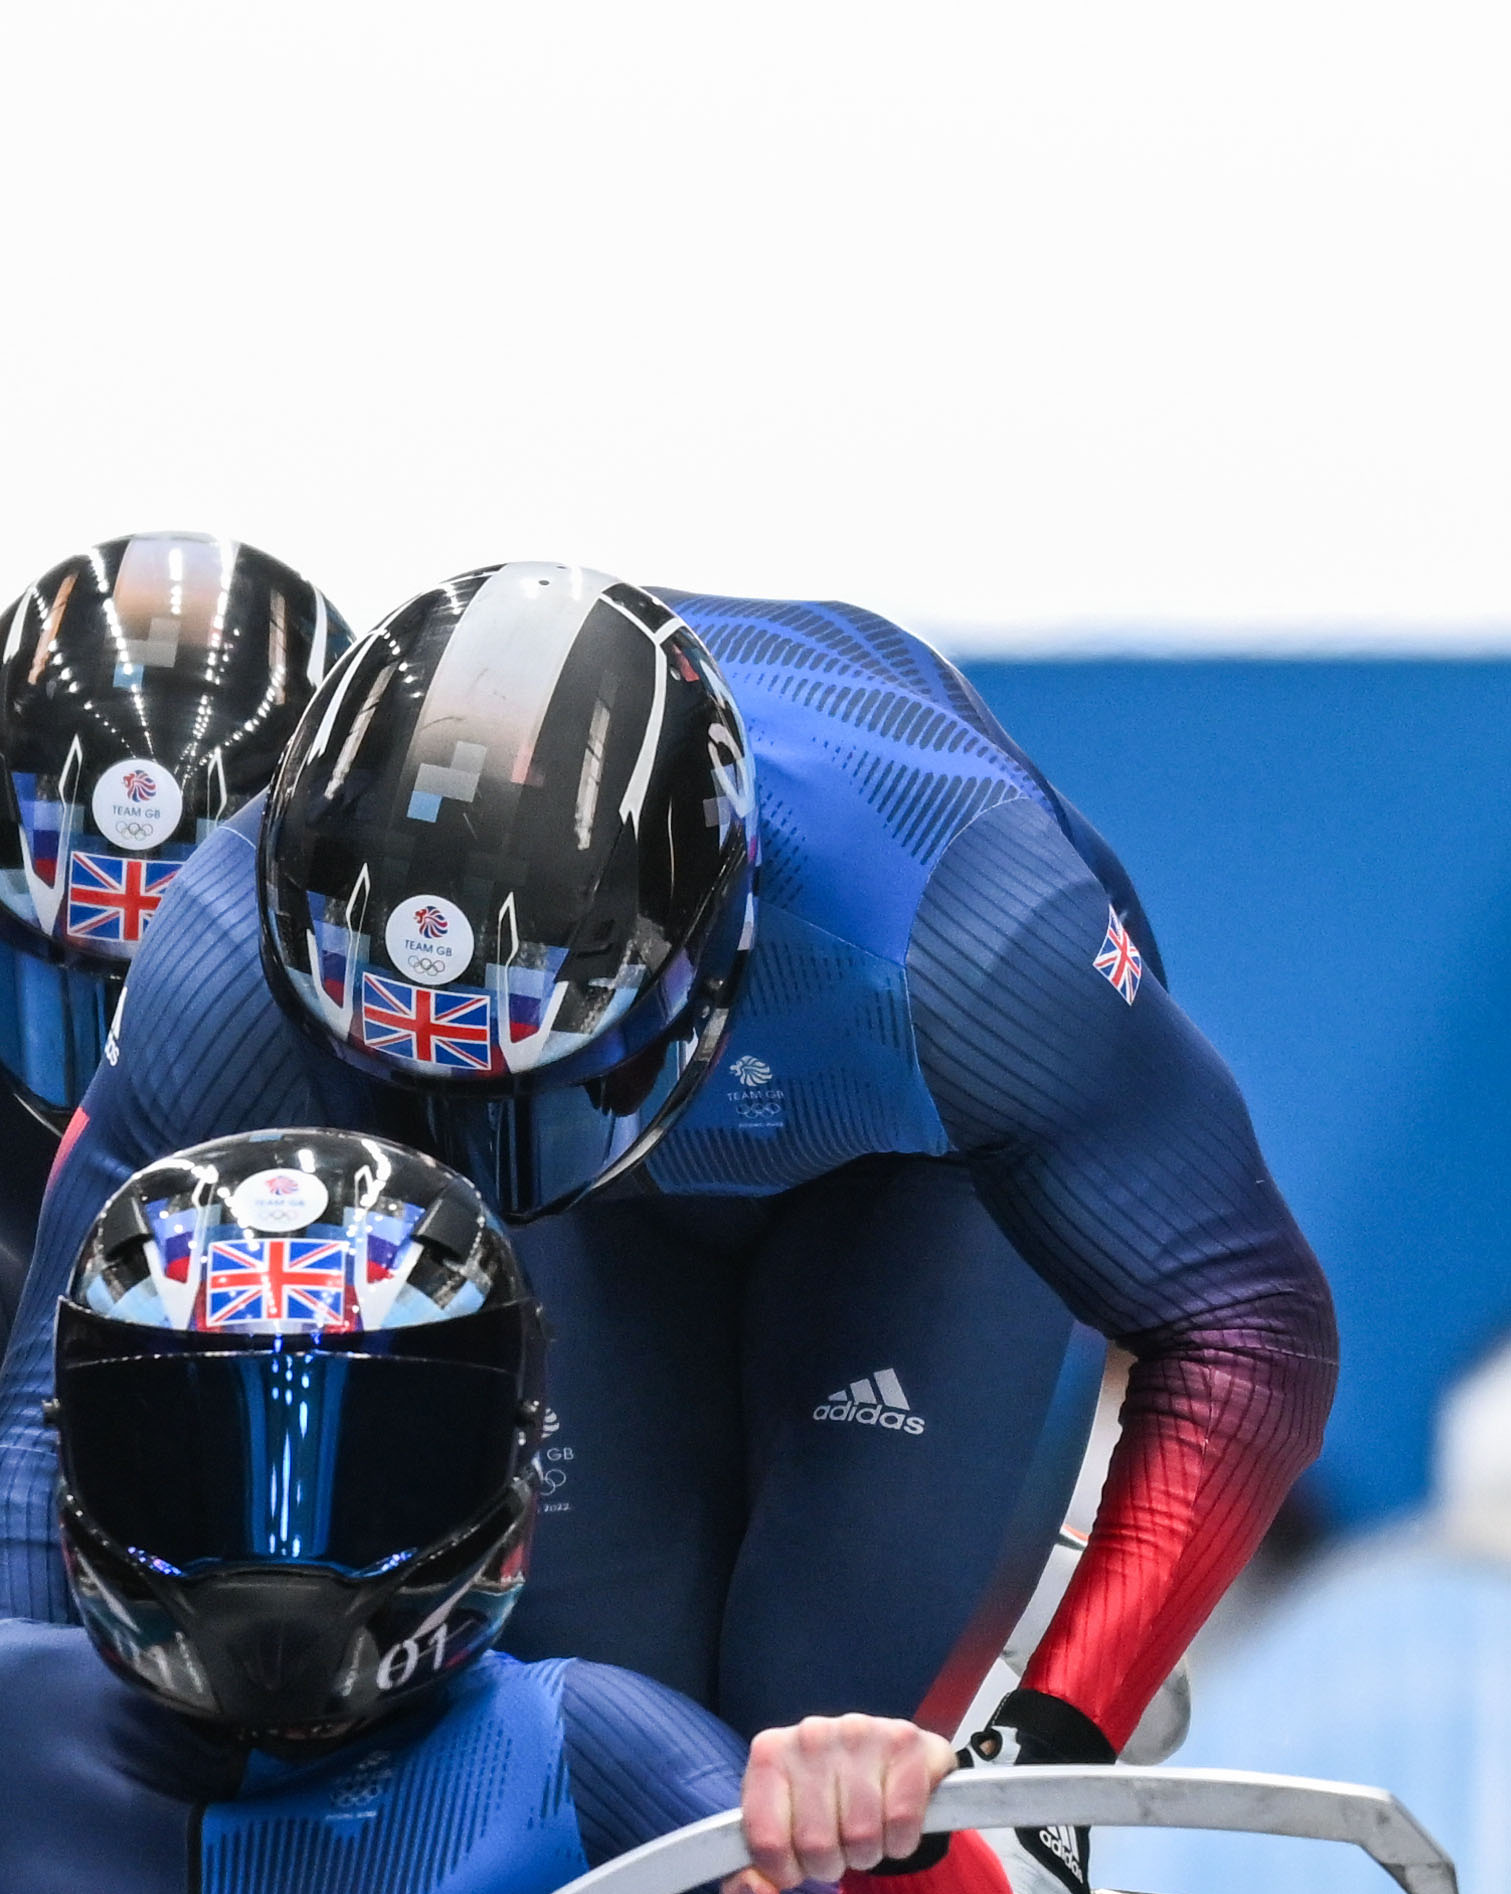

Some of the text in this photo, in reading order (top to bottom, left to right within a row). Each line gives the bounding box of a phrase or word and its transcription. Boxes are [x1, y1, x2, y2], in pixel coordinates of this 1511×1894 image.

[112, 805, 161, 819] TEAM GB
[405, 939, 453, 957] TEAM GB
[812, 1400, 926, 1435] adidas
[547, 1447, 574, 1461] GB
[376, 1623, 447, 1690] 01
